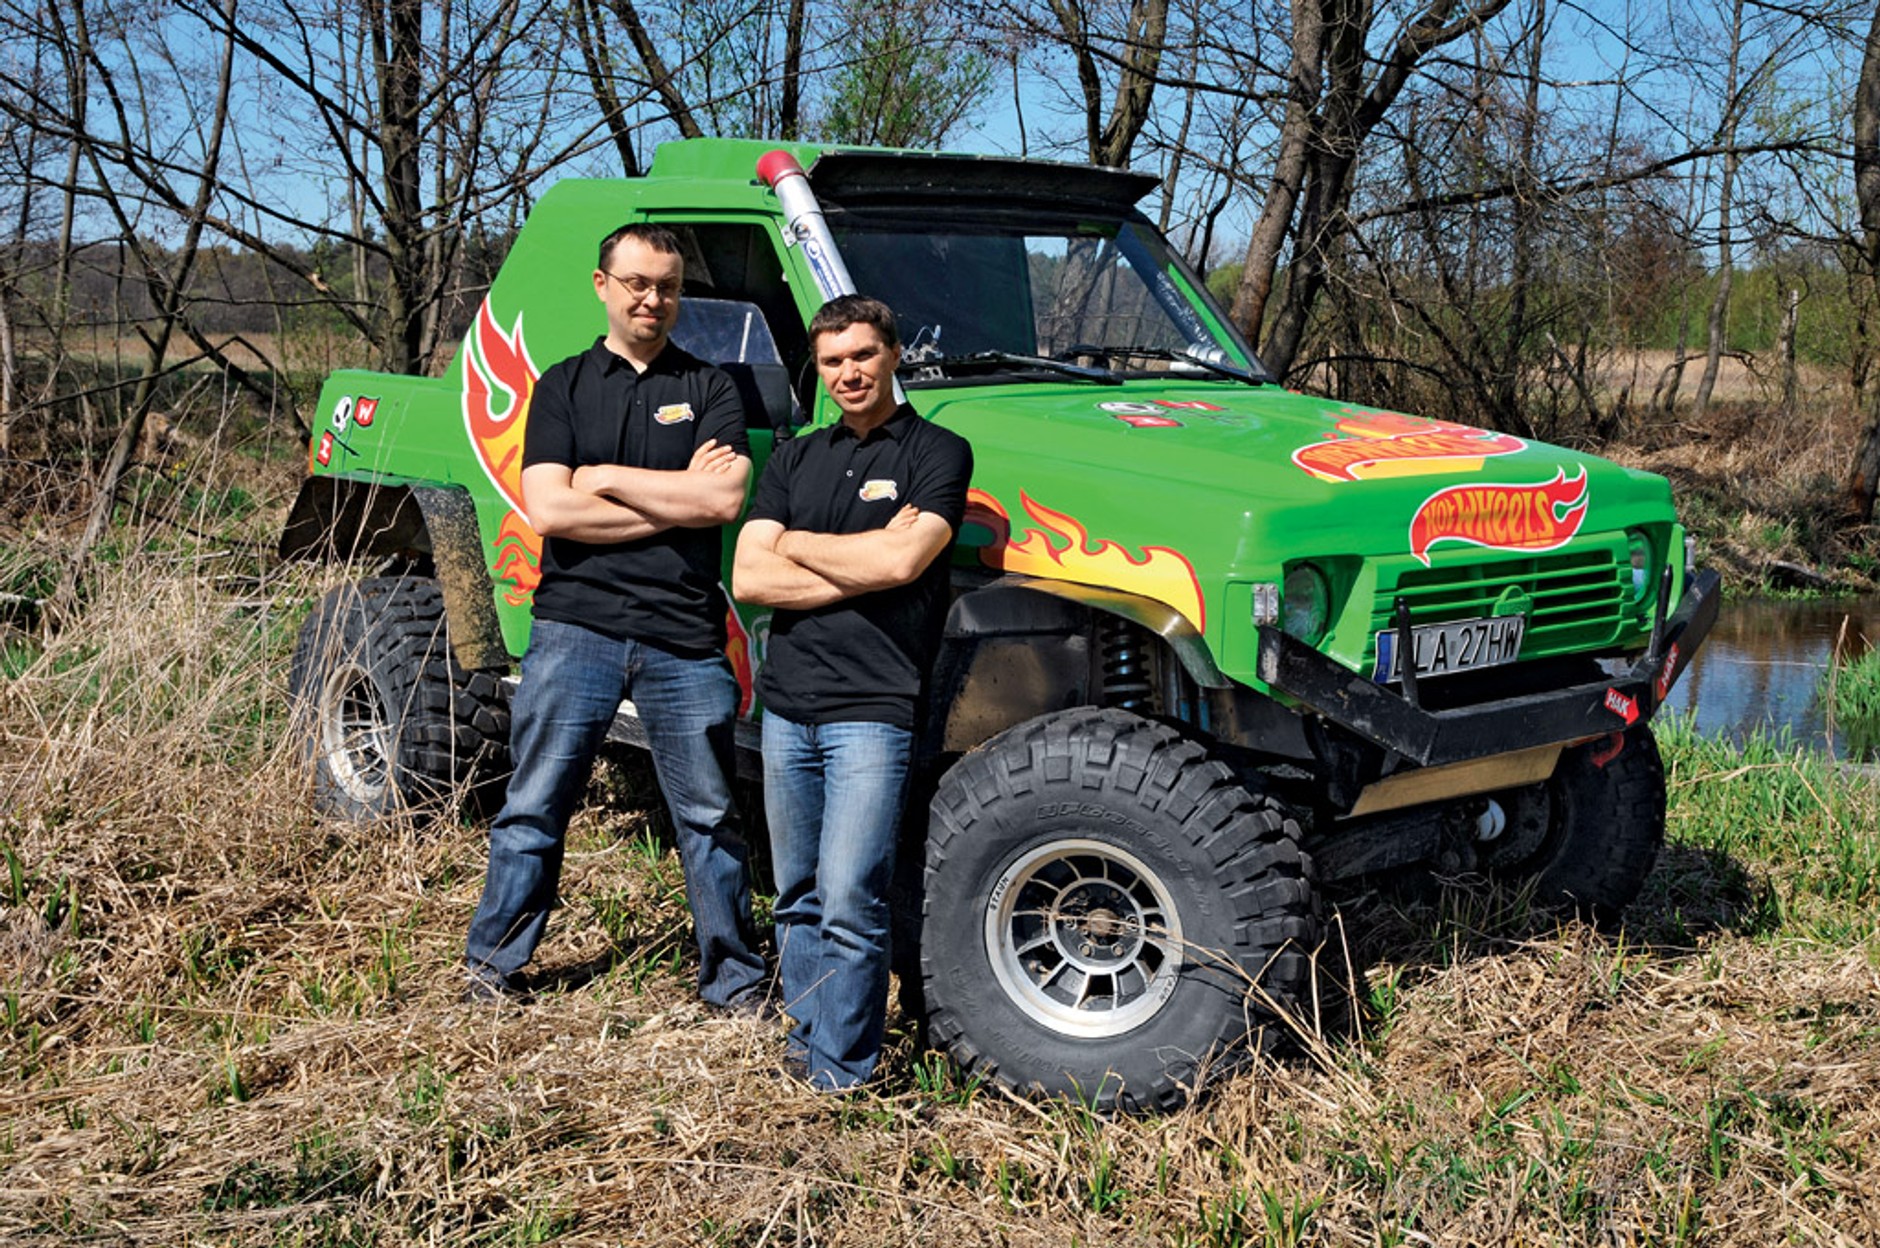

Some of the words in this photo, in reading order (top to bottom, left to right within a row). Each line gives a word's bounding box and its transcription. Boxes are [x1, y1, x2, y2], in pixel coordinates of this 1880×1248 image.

[1422, 498, 1455, 541] HOT
[1456, 620, 1522, 667] 27HW
[1606, 691, 1631, 717] HAK
